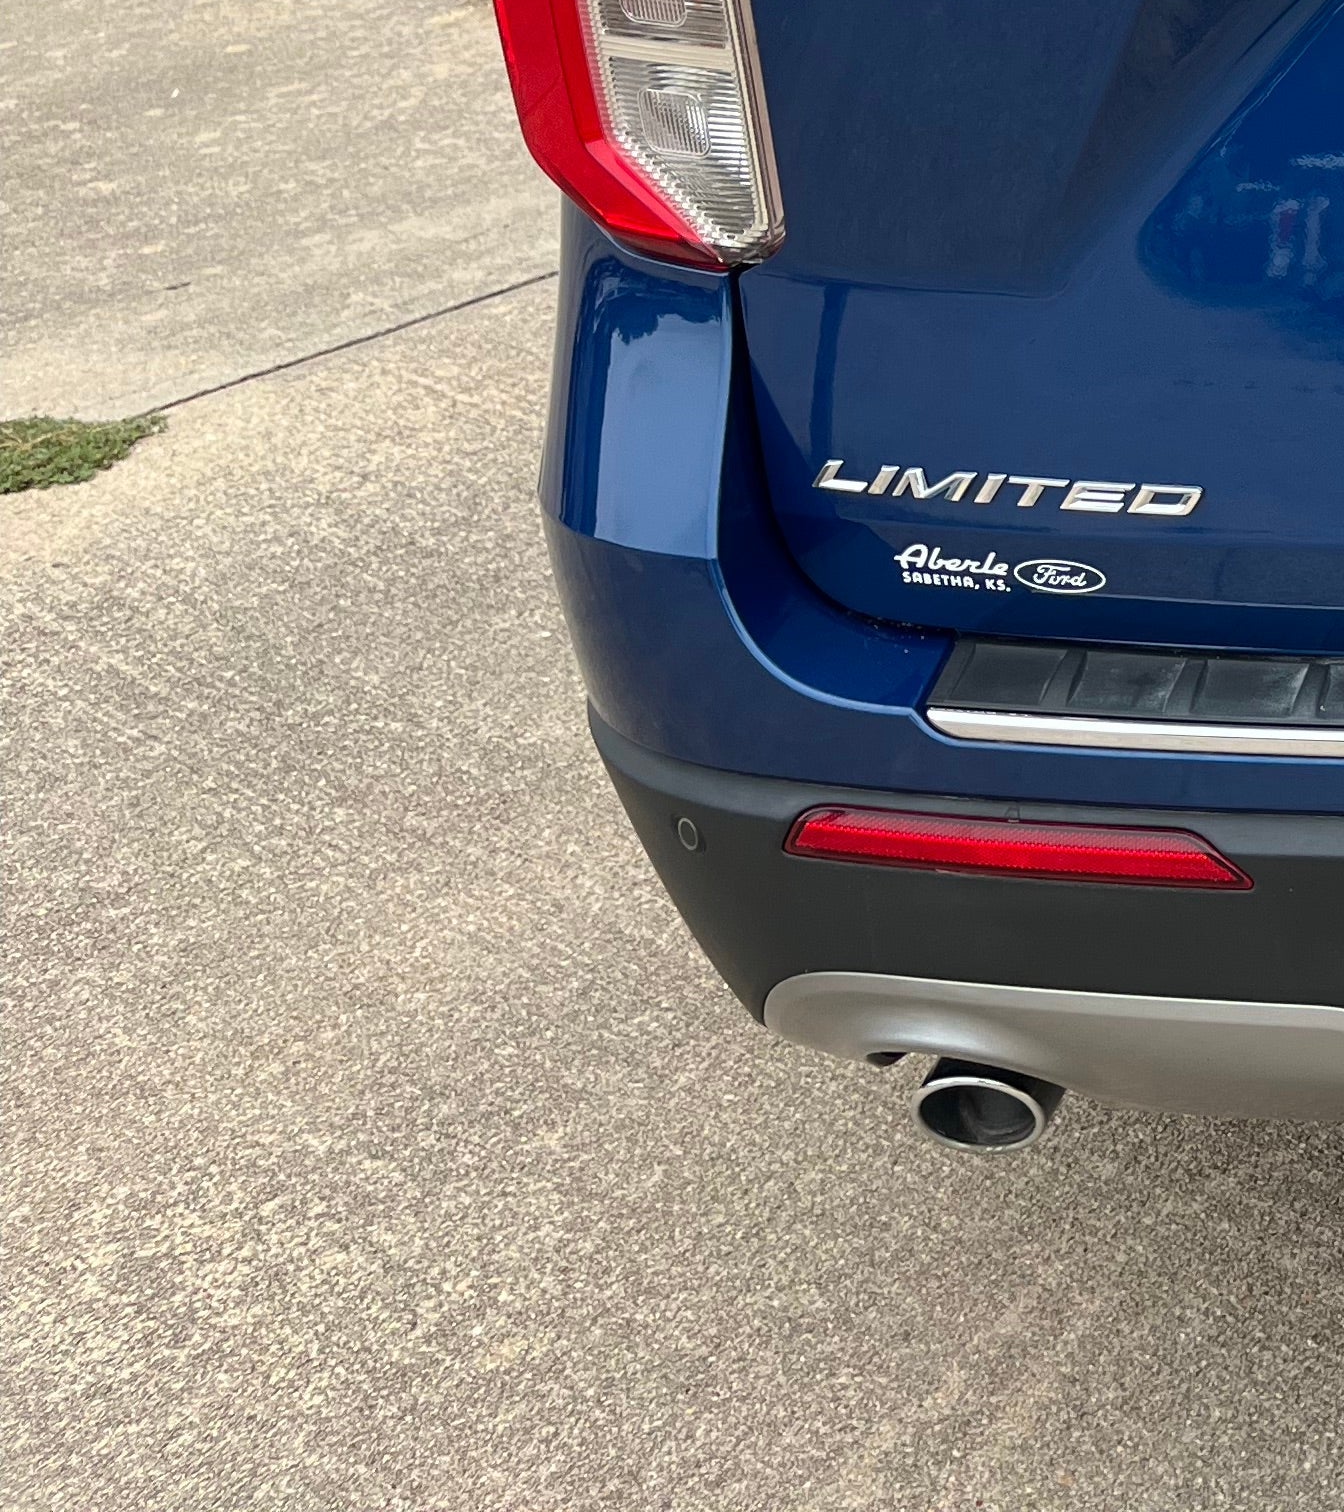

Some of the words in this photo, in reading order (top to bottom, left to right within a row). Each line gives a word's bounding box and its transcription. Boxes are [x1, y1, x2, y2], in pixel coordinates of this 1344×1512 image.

[811, 459, 1203, 517] LIMITED
[893, 543, 1009, 576] Aberle
[1033, 564, 1087, 587] Ford
[902, 571, 980, 590] SABETHA,
[985, 578, 1011, 593] KS.
